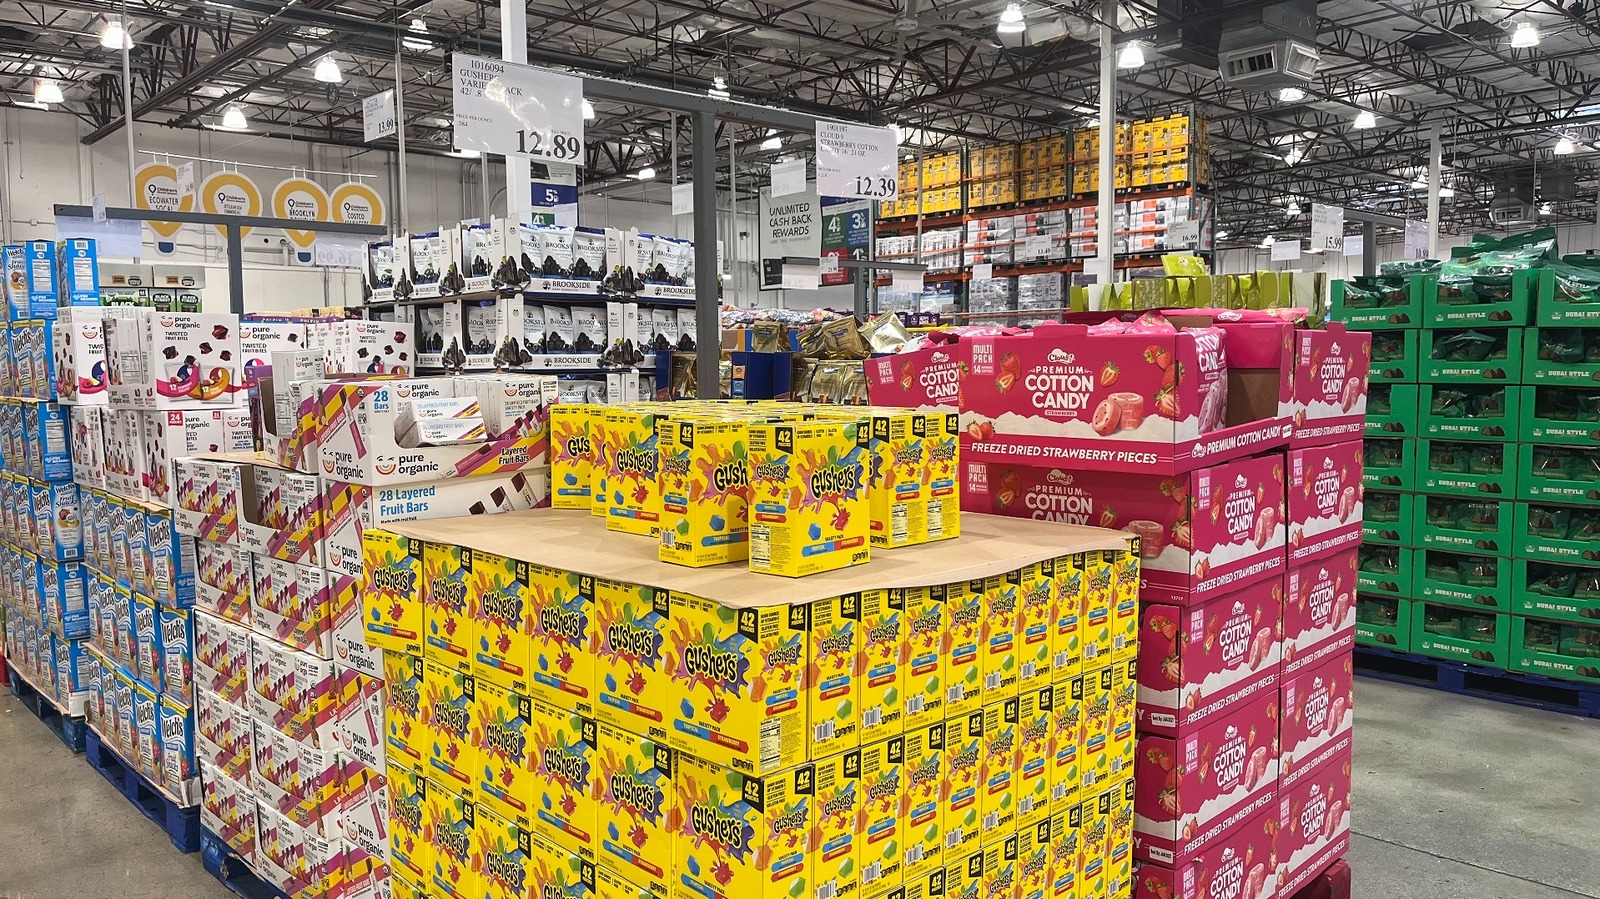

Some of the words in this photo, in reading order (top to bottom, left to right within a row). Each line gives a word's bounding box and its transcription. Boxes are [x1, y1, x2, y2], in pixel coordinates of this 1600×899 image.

[471, 60, 504, 73] 1016094
[379, 119, 393, 133] 13.99
[516, 130, 580, 160] 12.89
[820, 140, 856, 149] STRAWBERRY
[857, 143, 878, 151] COTTON
[855, 176, 895, 197] 12.39
[149, 196, 178, 205] ECOWATER
[289, 209, 315, 217] BROOKLYN
[769, 203, 810, 216] UNLIMITED
[770, 218, 789, 227] CASH
[792, 214, 812, 225] BACK
[773, 226, 809, 238] REWARDS
[1325, 236, 1341, 249] 15.99
[552, 280, 591, 289] BROOKSIDE
[174, 321, 200, 329] organic
[252, 332, 280, 340] organic
[973, 345, 992, 354] MULTI
[878, 361, 890, 369] MULTI
[973, 355, 992, 364] PACK
[973, 365, 980, 374] 14
[1036, 366, 1084, 374] PREMIUM
[1321, 364, 1345, 379] COTTON
[412, 382, 429, 390] pure
[518, 382, 534, 390] pure
[1025, 375, 1094, 392] COTTON
[1322, 380, 1344, 394] CANDY
[373, 390, 389, 402] 28
[412, 389, 439, 399] organic
[1032, 392, 1090, 409] CANDY
[875, 419, 887, 431] 42
[681, 426, 692, 438] 42
[778, 431, 791, 442] 42
[1207, 434, 1236, 455] PREMIUM
[1237, 430, 1262, 447] COTTON
[1262, 425, 1281, 441] CANDY
[335, 450, 352, 463] pure
[501, 445, 528, 456] Layered
[896, 449, 921, 463] Gushers
[971, 442, 1007, 454] FREEZE
[1009, 445, 1041, 456] DRIED
[1042, 447, 1115, 461] STRAWBERRY
[1117, 451, 1157, 464] PIECES
[399, 454, 424, 466] pure
[498, 456, 514, 465] Fruit
[515, 454, 529, 463] Bars
[617, 448, 653, 473] Gushers
[336, 465, 364, 480] organic
[399, 461, 439, 475] organic
[756, 464, 785, 478] Gushers
[811, 465, 855, 496] Gushers
[380, 489, 394, 501] 28
[396, 485, 436, 500] Layered
[1036, 484, 1083, 495] PREMIUM
[55, 499, 76, 507] Snacks
[380, 504, 405, 517] Fruit
[407, 500, 429, 513] Bars
[1025, 493, 1093, 514] COTTON
[1225, 497, 1255, 518] COTTON
[1228, 514, 1254, 534] CANDY
[150, 521, 169, 547] Welch's
[373, 567, 409, 590] Gushers
[1196, 578, 1216, 593] FREEZE
[1217, 573, 1233, 587] DRIED
[1234, 562, 1265, 581] STRAWBERRY
[1265, 557, 1280, 571] PIECES
[432, 576, 461, 603] Gushers
[540, 606, 580, 637] Gushers
[741, 612, 755, 627] 42
[161, 621, 185, 643] Welch's
[741, 625, 755, 634] POUCHES
[608, 622, 653, 658] Gushers
[1452, 646, 1470, 654] STYLE
[685, 643, 737, 680] Gushers
[161, 717, 183, 738] Welch's
[352, 732, 367, 745] pure
[718, 735, 740, 746] STRAWBERRY
[353, 746, 377, 765] organic
[611, 773, 654, 811] Gushers
[744, 782, 760, 795] 42
[691, 804, 742, 847] Gushers
